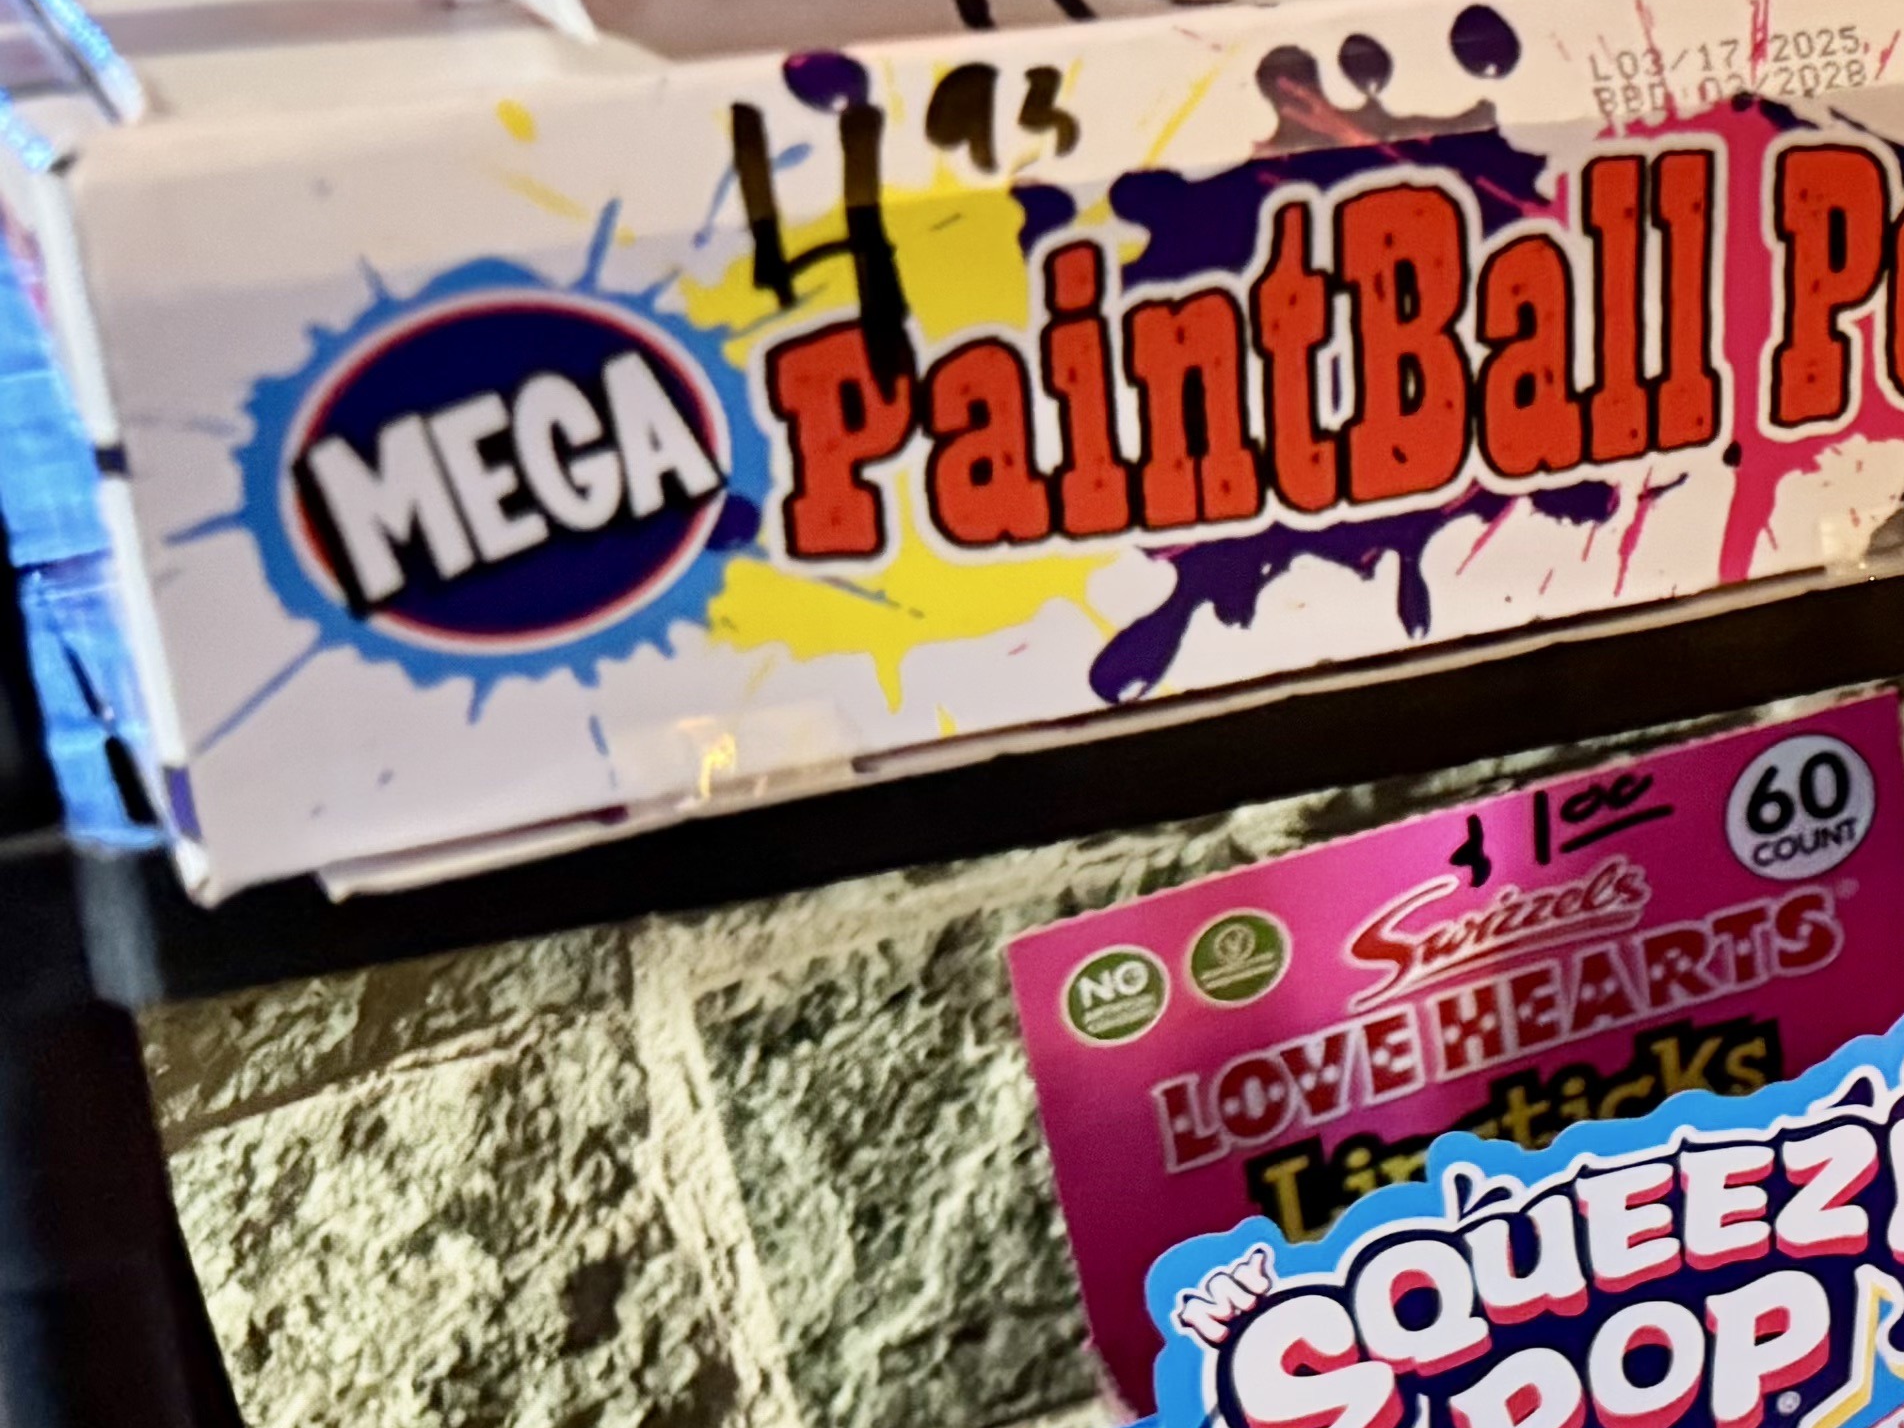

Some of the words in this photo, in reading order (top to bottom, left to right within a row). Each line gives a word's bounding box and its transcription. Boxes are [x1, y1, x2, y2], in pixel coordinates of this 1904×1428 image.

[304, 351, 719, 608] MEGA
[765, 147, 1724, 560] PaintBall
[1746, 746, 1850, 832] 60
[1750, 817, 1867, 870] COUNT
[1078, 960, 1149, 1008] NO
[1155, 997, 1427, 1172] LOVE
[1438, 890, 1847, 1082] HEARTS
